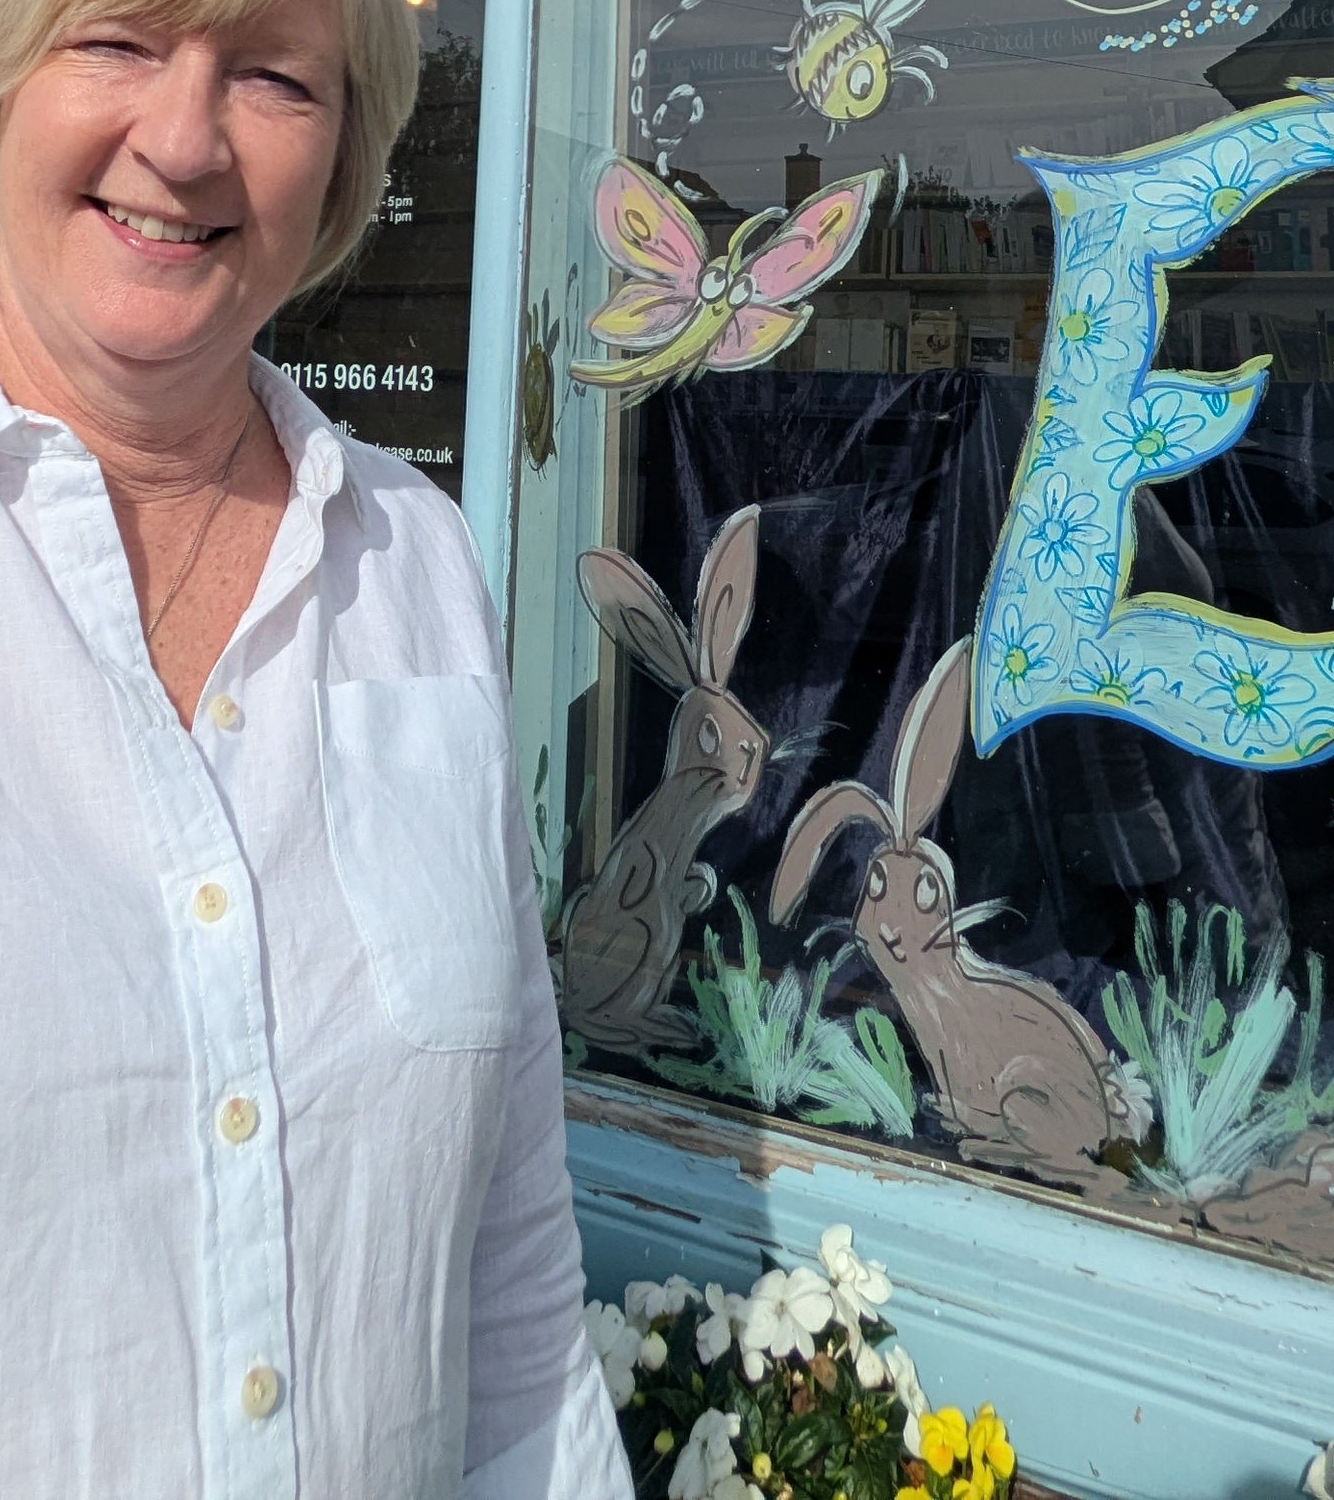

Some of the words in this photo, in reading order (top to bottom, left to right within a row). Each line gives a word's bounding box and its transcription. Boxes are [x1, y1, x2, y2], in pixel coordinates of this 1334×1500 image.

[387, 195, 413, 209] 5pm
[389, 211, 412, 225] 1pm
[334, 364, 377, 390] 966
[381, 364, 434, 392] 4143
